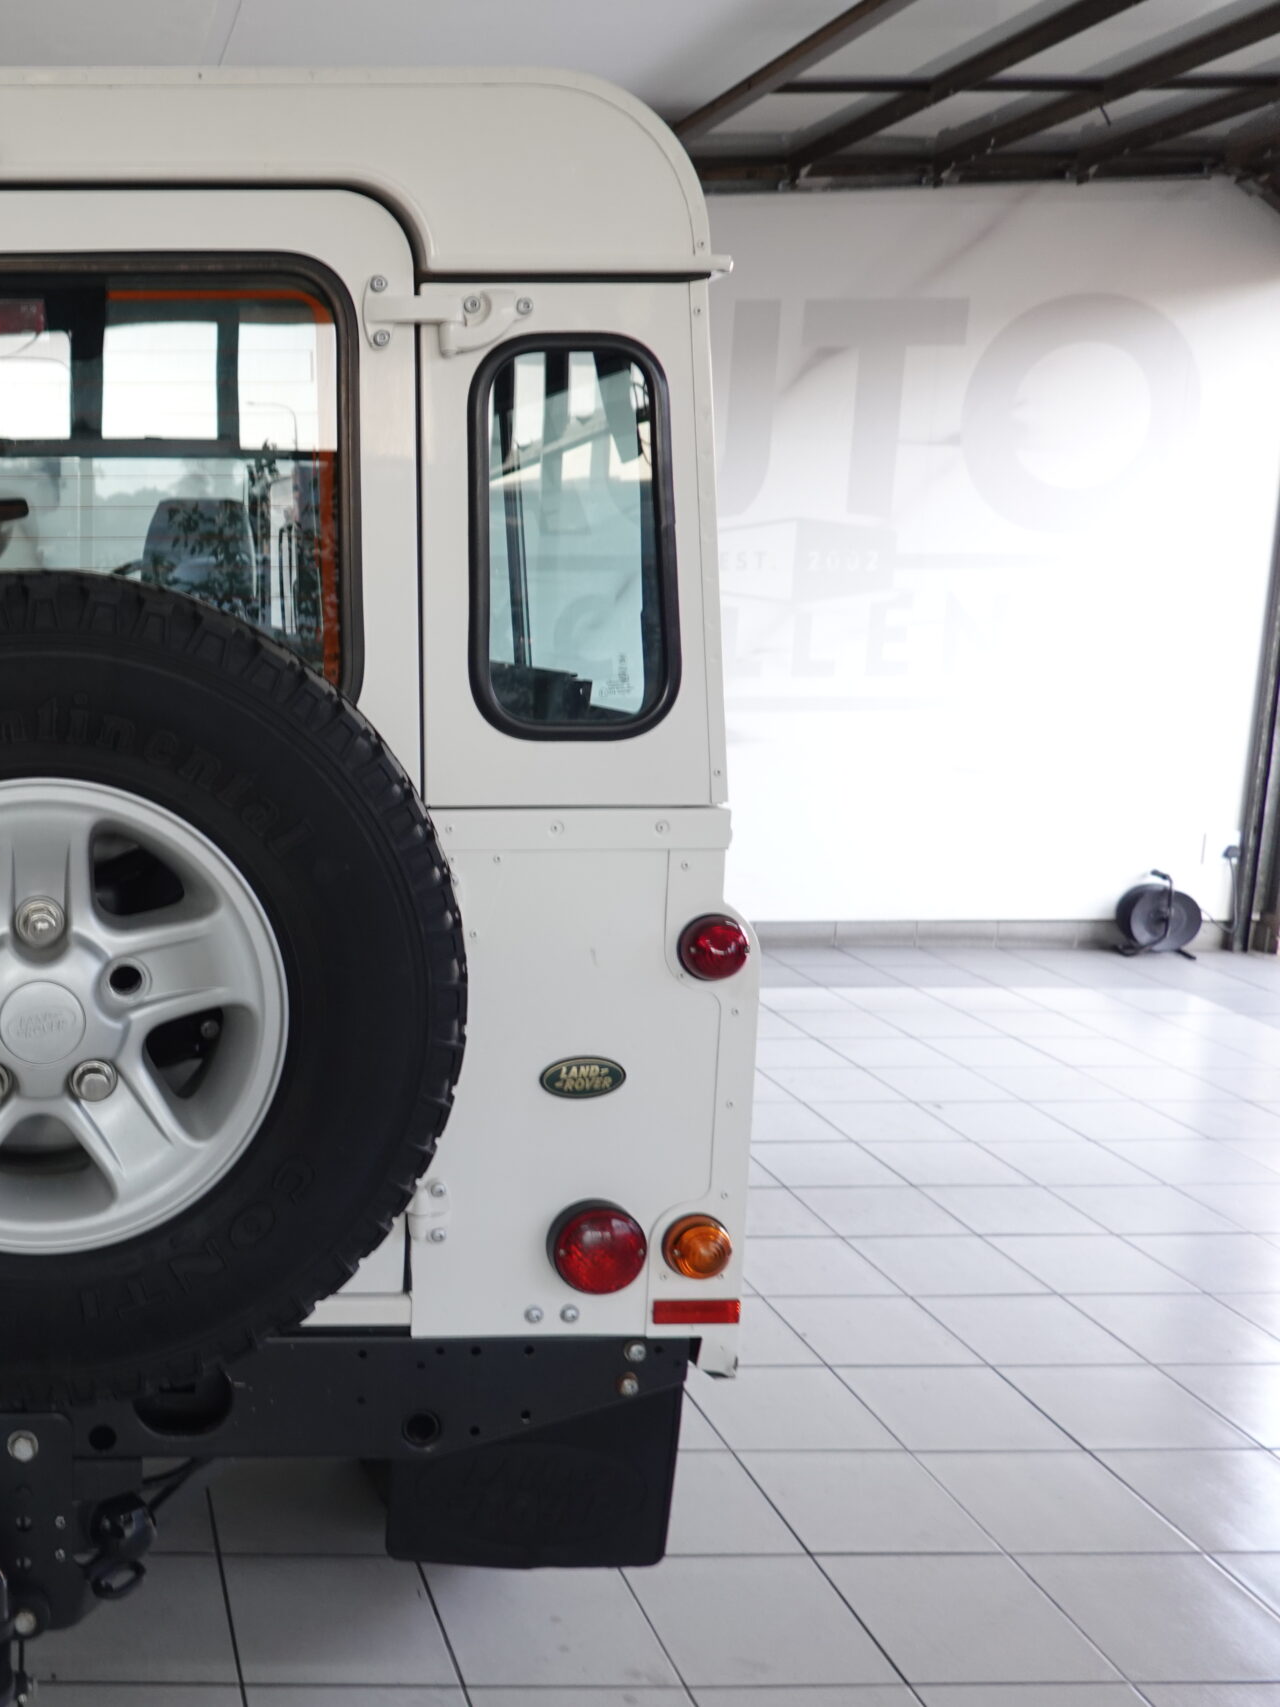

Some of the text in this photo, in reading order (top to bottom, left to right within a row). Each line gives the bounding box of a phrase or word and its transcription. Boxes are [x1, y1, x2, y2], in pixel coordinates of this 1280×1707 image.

[808, 550, 879, 571] 2002
[560, 1065, 600, 1079] LAND
[563, 1076, 612, 1092] ROVER
